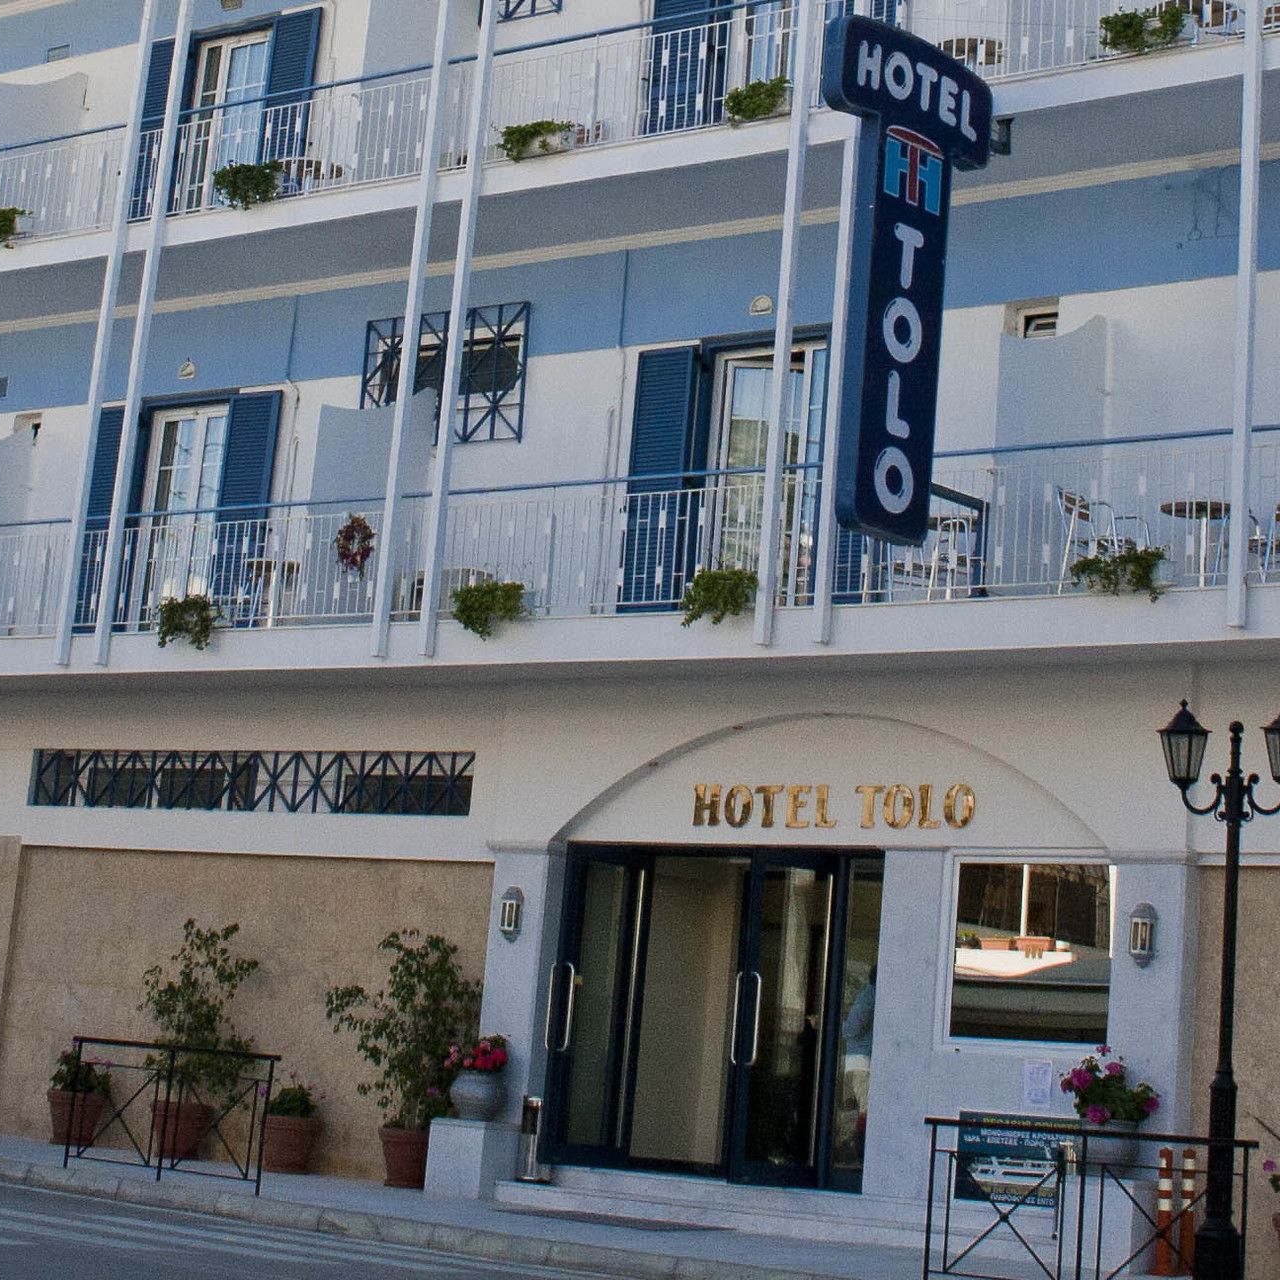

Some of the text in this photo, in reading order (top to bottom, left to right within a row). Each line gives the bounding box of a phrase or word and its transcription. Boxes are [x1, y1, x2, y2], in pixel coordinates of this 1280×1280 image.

[856, 38, 977, 143] HOTEL
[873, 221, 925, 515] TOLO
[691, 783, 977, 830] HOTEL TOLO
